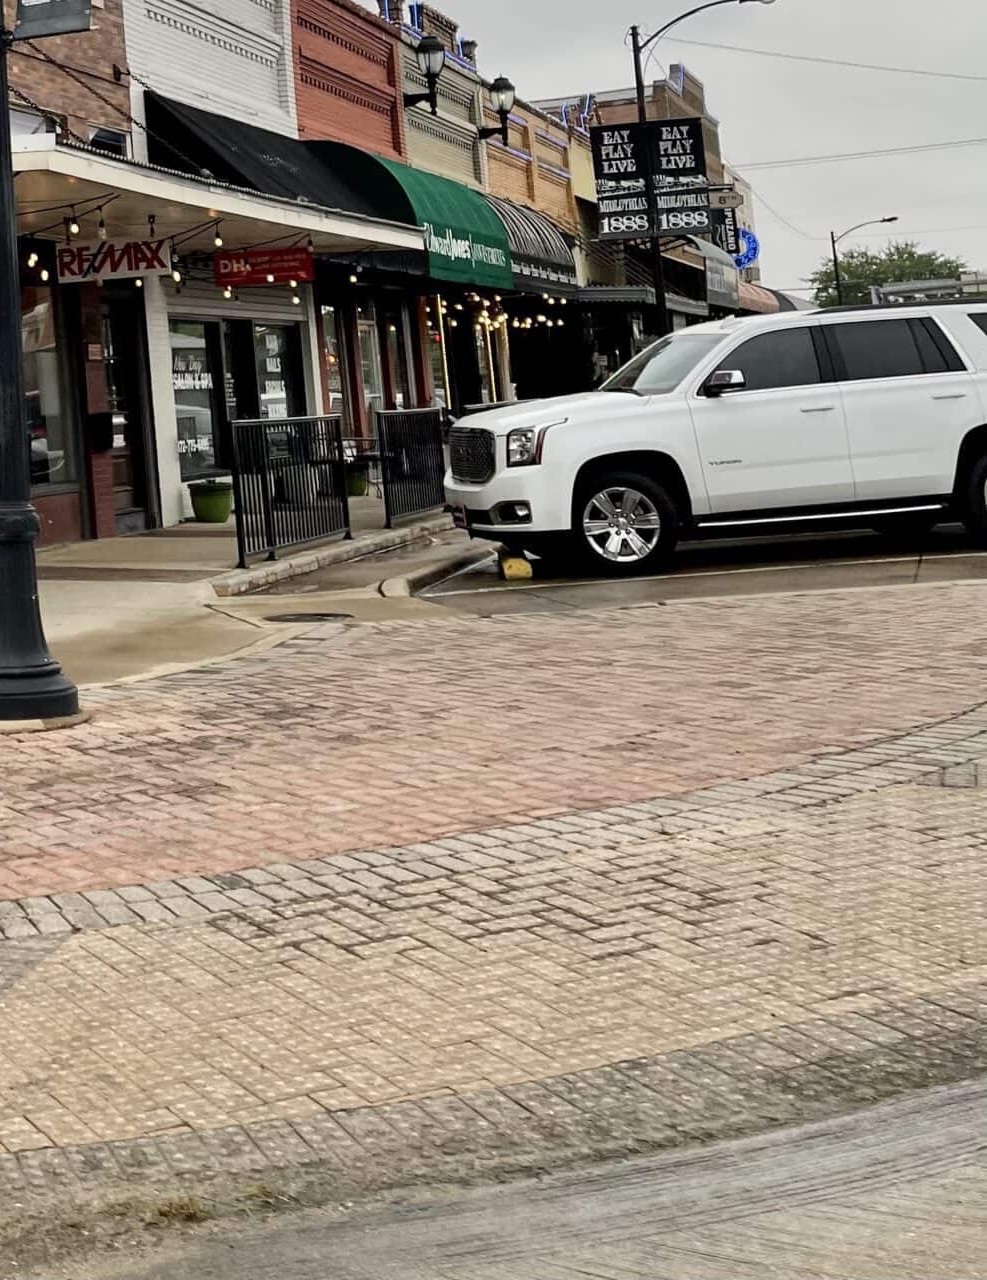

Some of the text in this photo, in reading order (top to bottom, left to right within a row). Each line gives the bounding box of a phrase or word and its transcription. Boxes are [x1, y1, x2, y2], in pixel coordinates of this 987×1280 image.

[602, 130, 631, 145] EAT
[661, 126, 690, 140] EAT
[600, 143, 634, 159] PLAY
[659, 139, 694, 155] PLAY
[601, 158, 636, 174] LIVE
[660, 154, 696, 169] LIVE
[600, 214, 649, 234] 1888
[659, 210, 709, 230] 1888
[57, 240, 167, 278] RE/MAX
